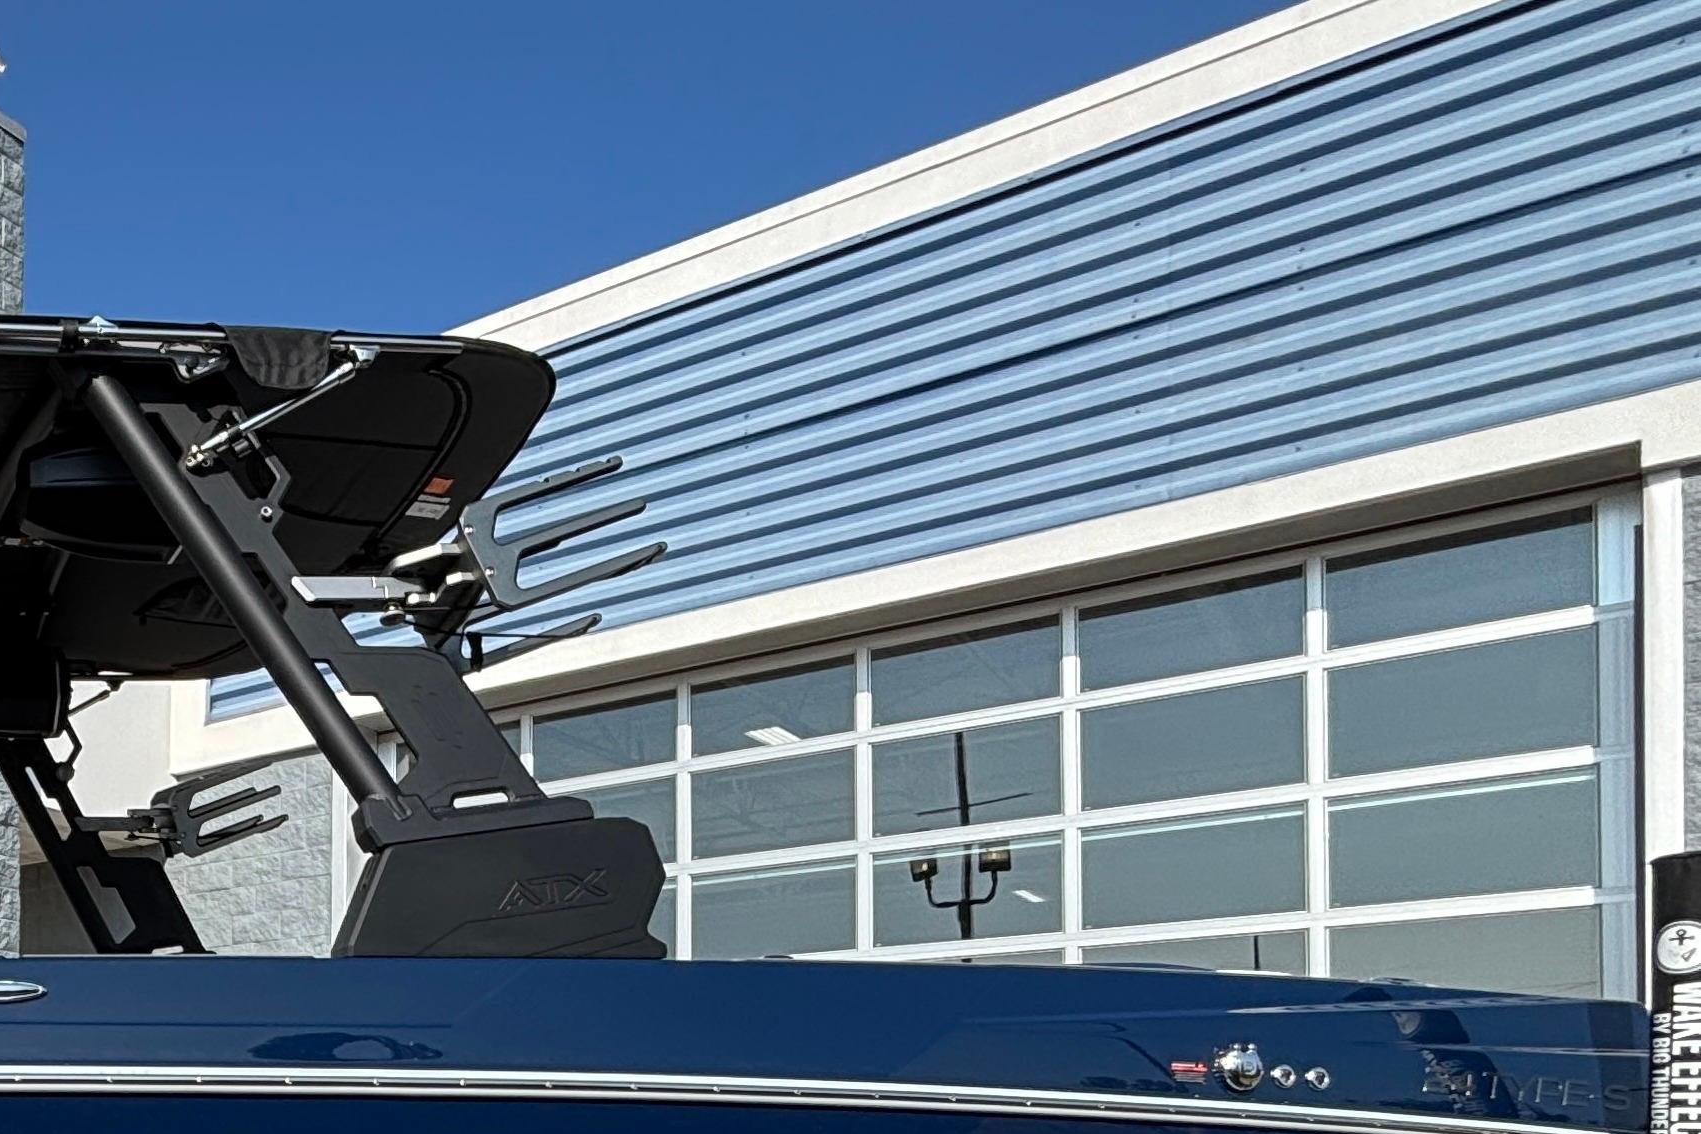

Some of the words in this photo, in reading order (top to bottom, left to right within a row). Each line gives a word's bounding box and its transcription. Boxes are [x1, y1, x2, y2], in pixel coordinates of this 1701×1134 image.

[499, 867, 609, 912] ATX
[1653, 1012, 1672, 1032] BY
[1652, 1038, 1671, 1064] BIG
